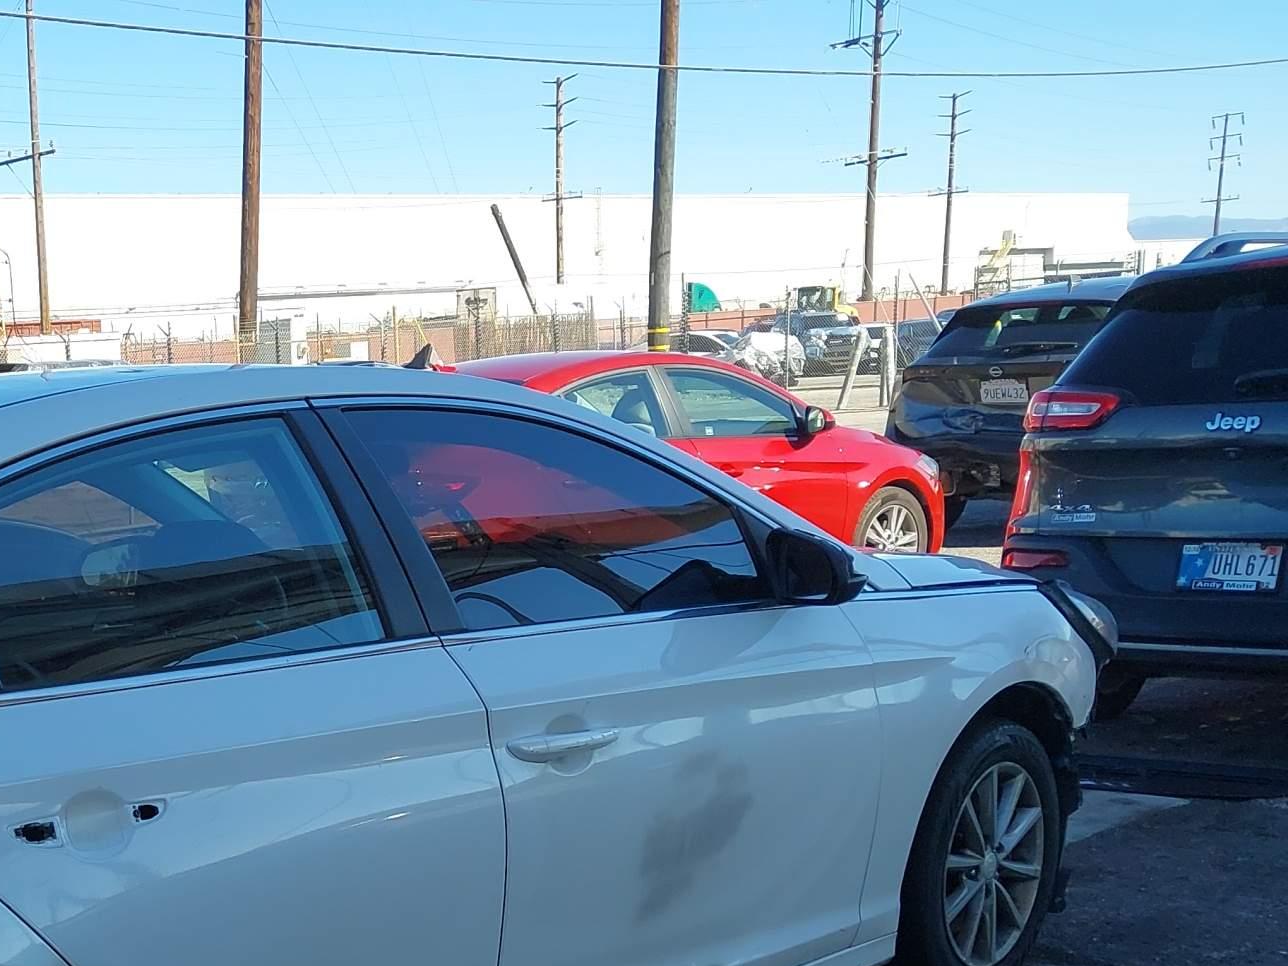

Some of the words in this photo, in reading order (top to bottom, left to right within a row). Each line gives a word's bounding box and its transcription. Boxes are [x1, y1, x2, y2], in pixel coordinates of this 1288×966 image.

[983, 387, 1025, 400] 9UEW432
[1206, 412, 1261, 433] Jeep
[1212, 553, 1277, 577] UHL671
[1196, 581, 1222, 590] Andy
